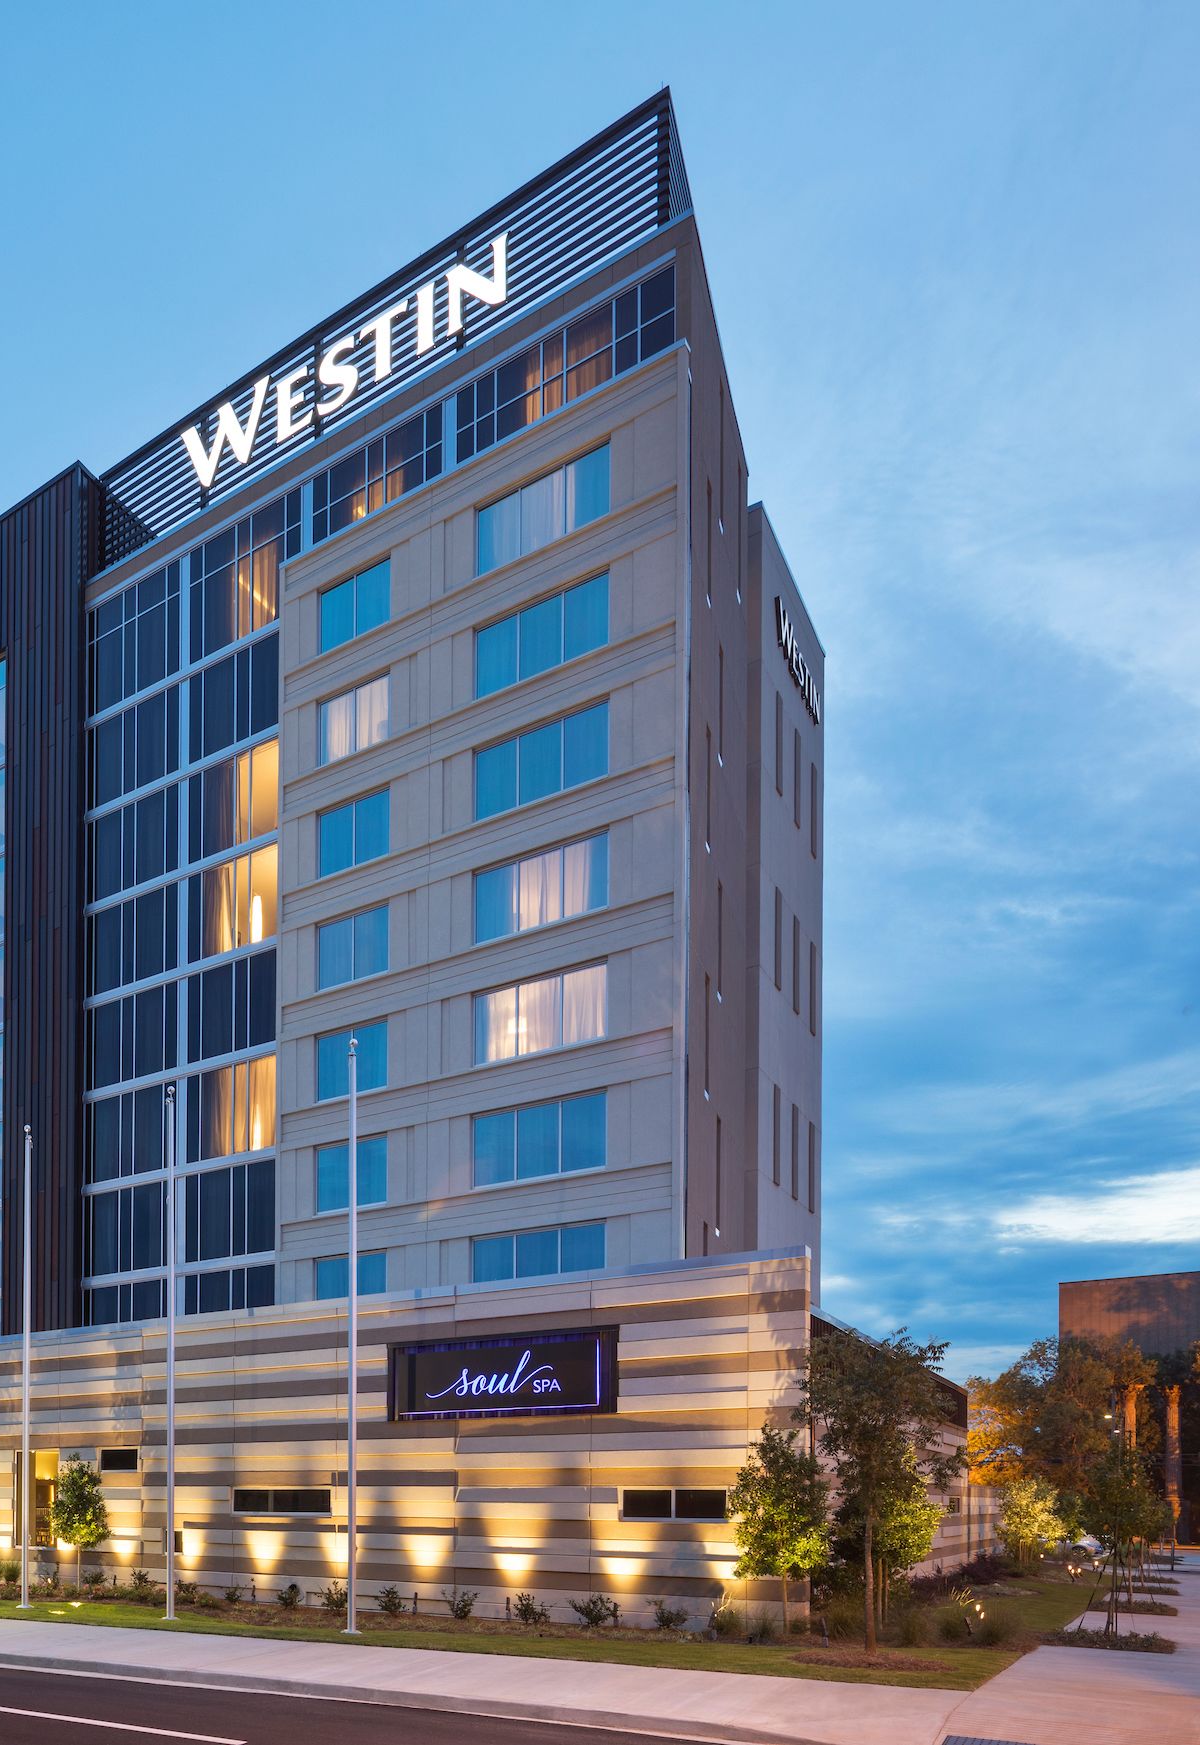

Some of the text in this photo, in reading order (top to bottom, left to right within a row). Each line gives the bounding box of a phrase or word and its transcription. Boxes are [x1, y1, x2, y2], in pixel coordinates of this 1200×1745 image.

[180, 232, 510, 487] WESTIN
[775, 596, 820, 725] WESTIN
[426, 1350, 561, 1398] soul SPA
